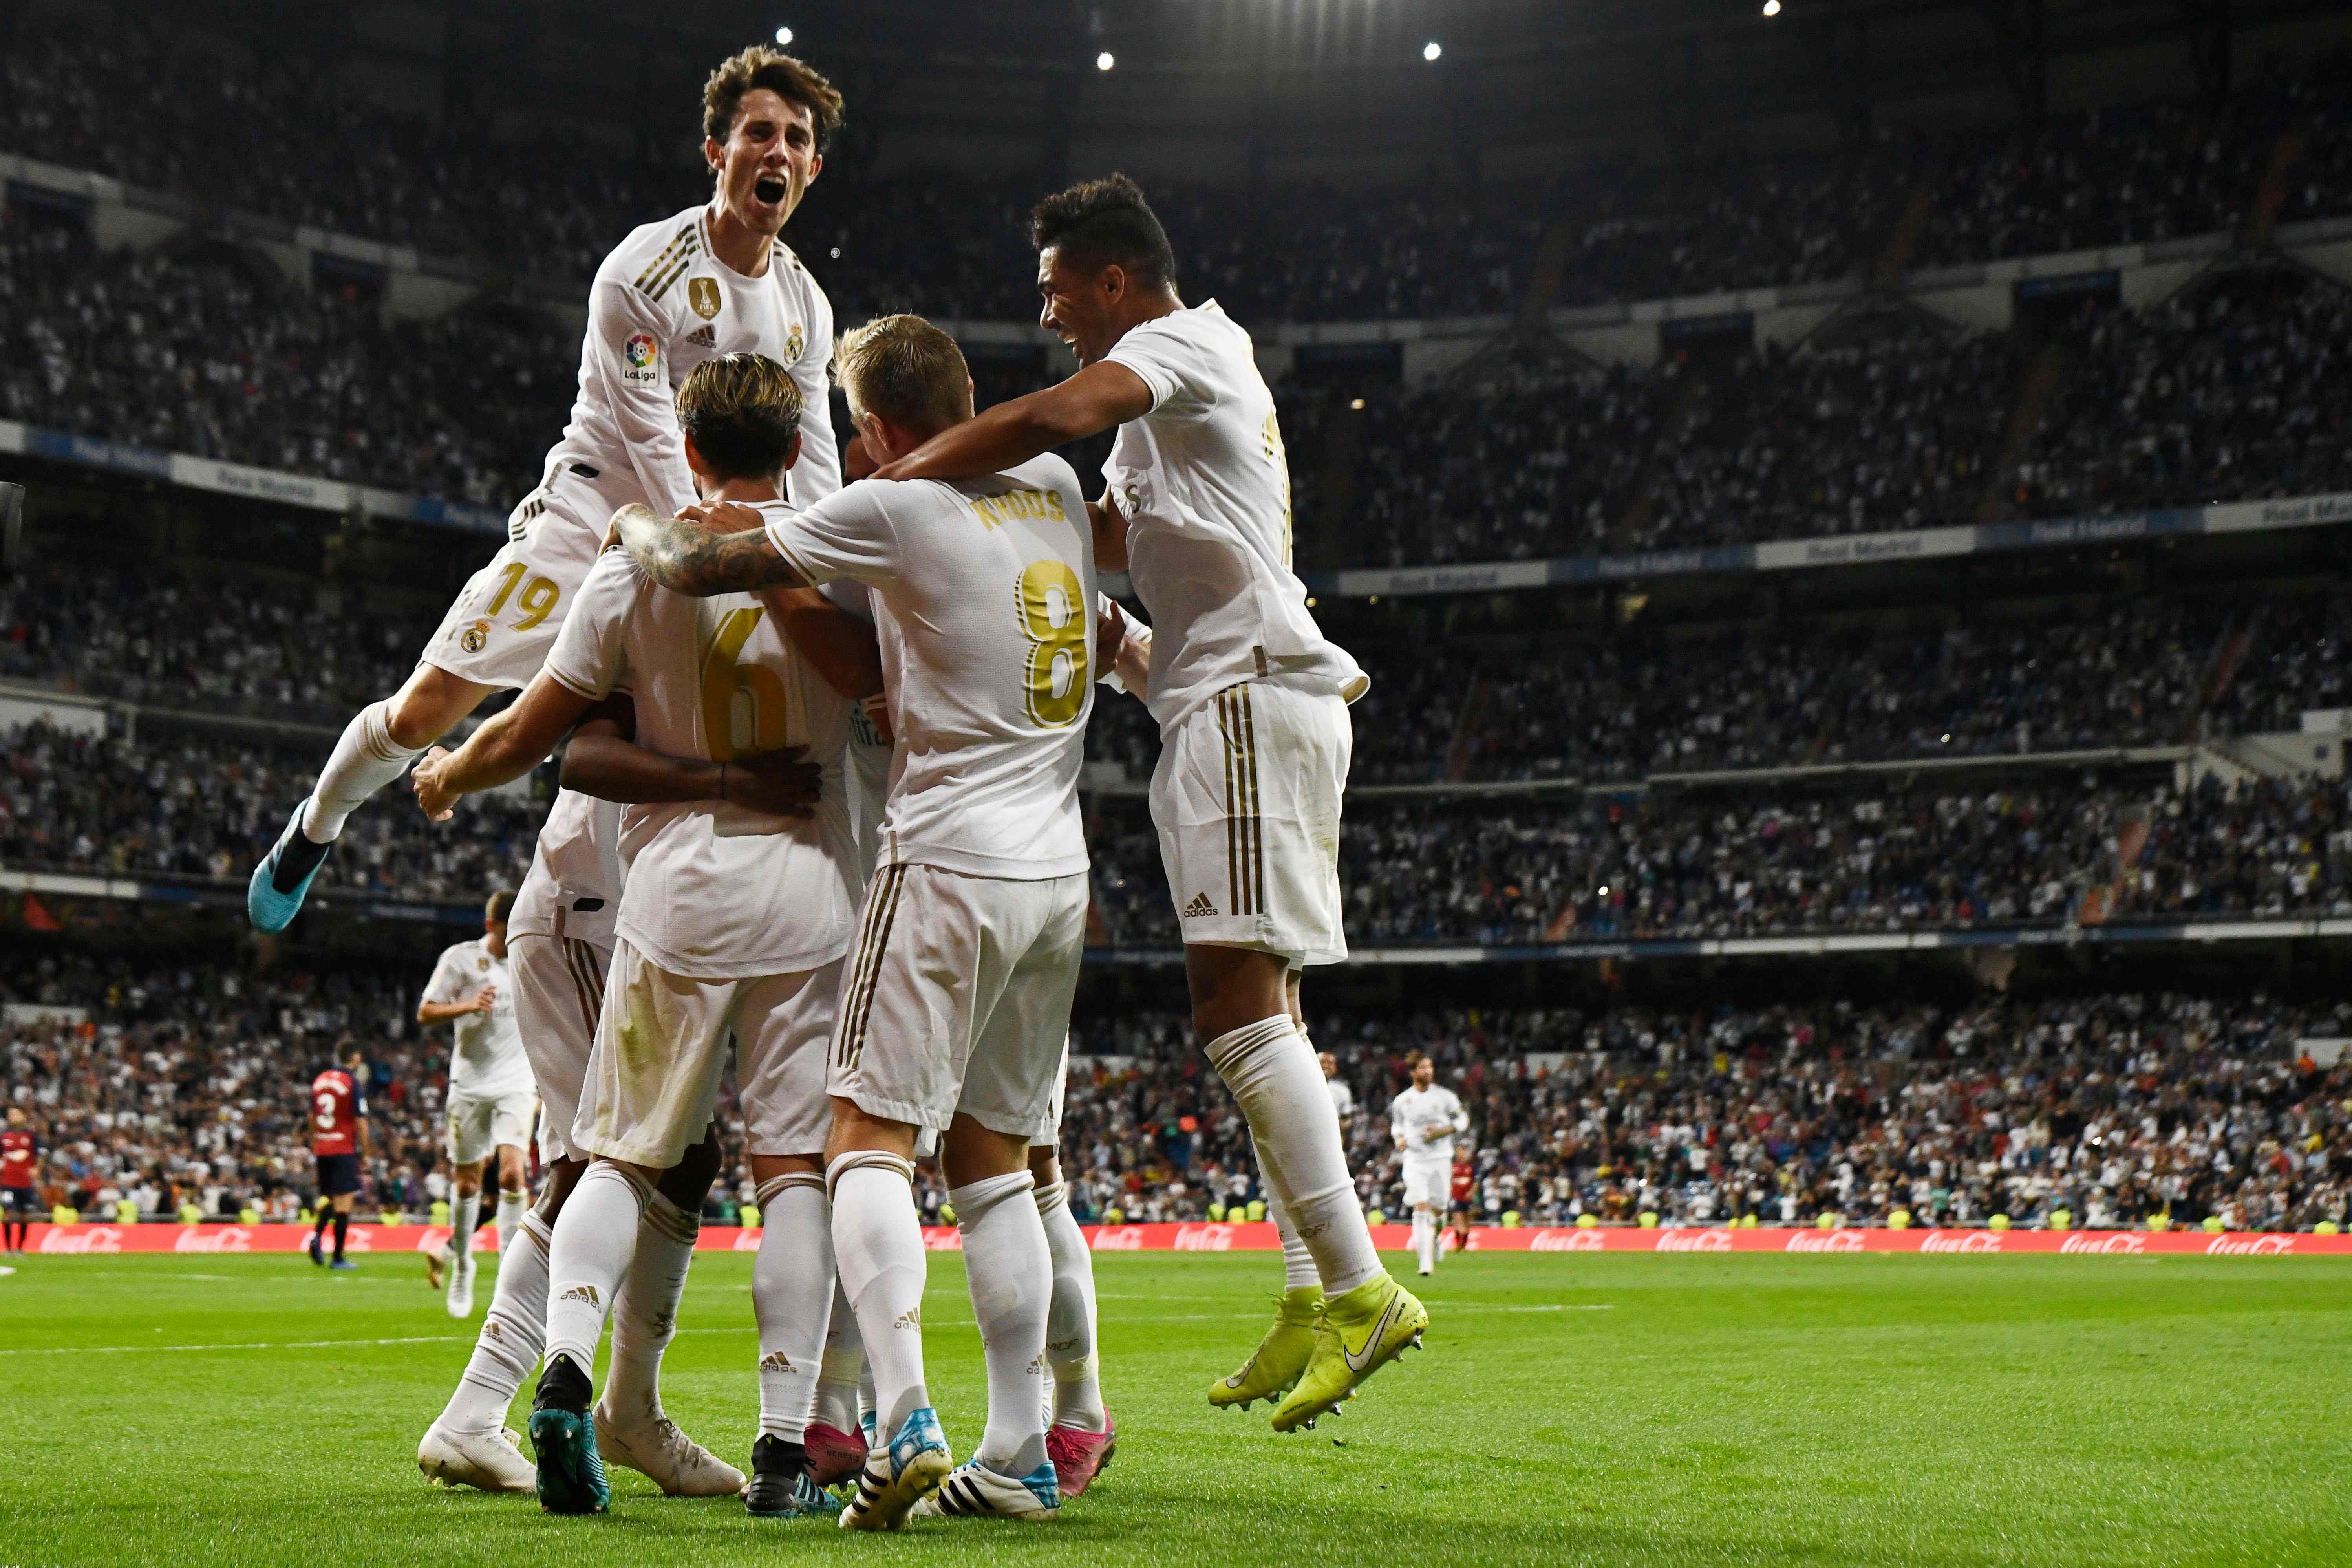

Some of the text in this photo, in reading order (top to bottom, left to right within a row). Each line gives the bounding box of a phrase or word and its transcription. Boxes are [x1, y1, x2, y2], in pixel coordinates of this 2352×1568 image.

[625, 370, 655, 381] LaLiga
[485, 562, 560, 633] 19
[1015, 560, 1088, 728] 8
[699, 607, 786, 764] 6
[1184, 908, 1218, 918] adidas
[316, 1093, 336, 1129] 3
[1174, 1224, 1234, 1250] Coca-Cola
[1531, 1230, 1606, 1251] Coca-Cola
[1656, 1230, 1734, 1252] Coca-Cola
[1785, 1230, 1866, 1252] Coca-Cola
[1920, 1230, 2003, 1253] Coca-Cola
[2060, 1233, 2146, 1254] Coca-Cola
[2206, 1234, 2297, 1255] Coca-Cola
[560, 1293, 602, 1313] adidas
